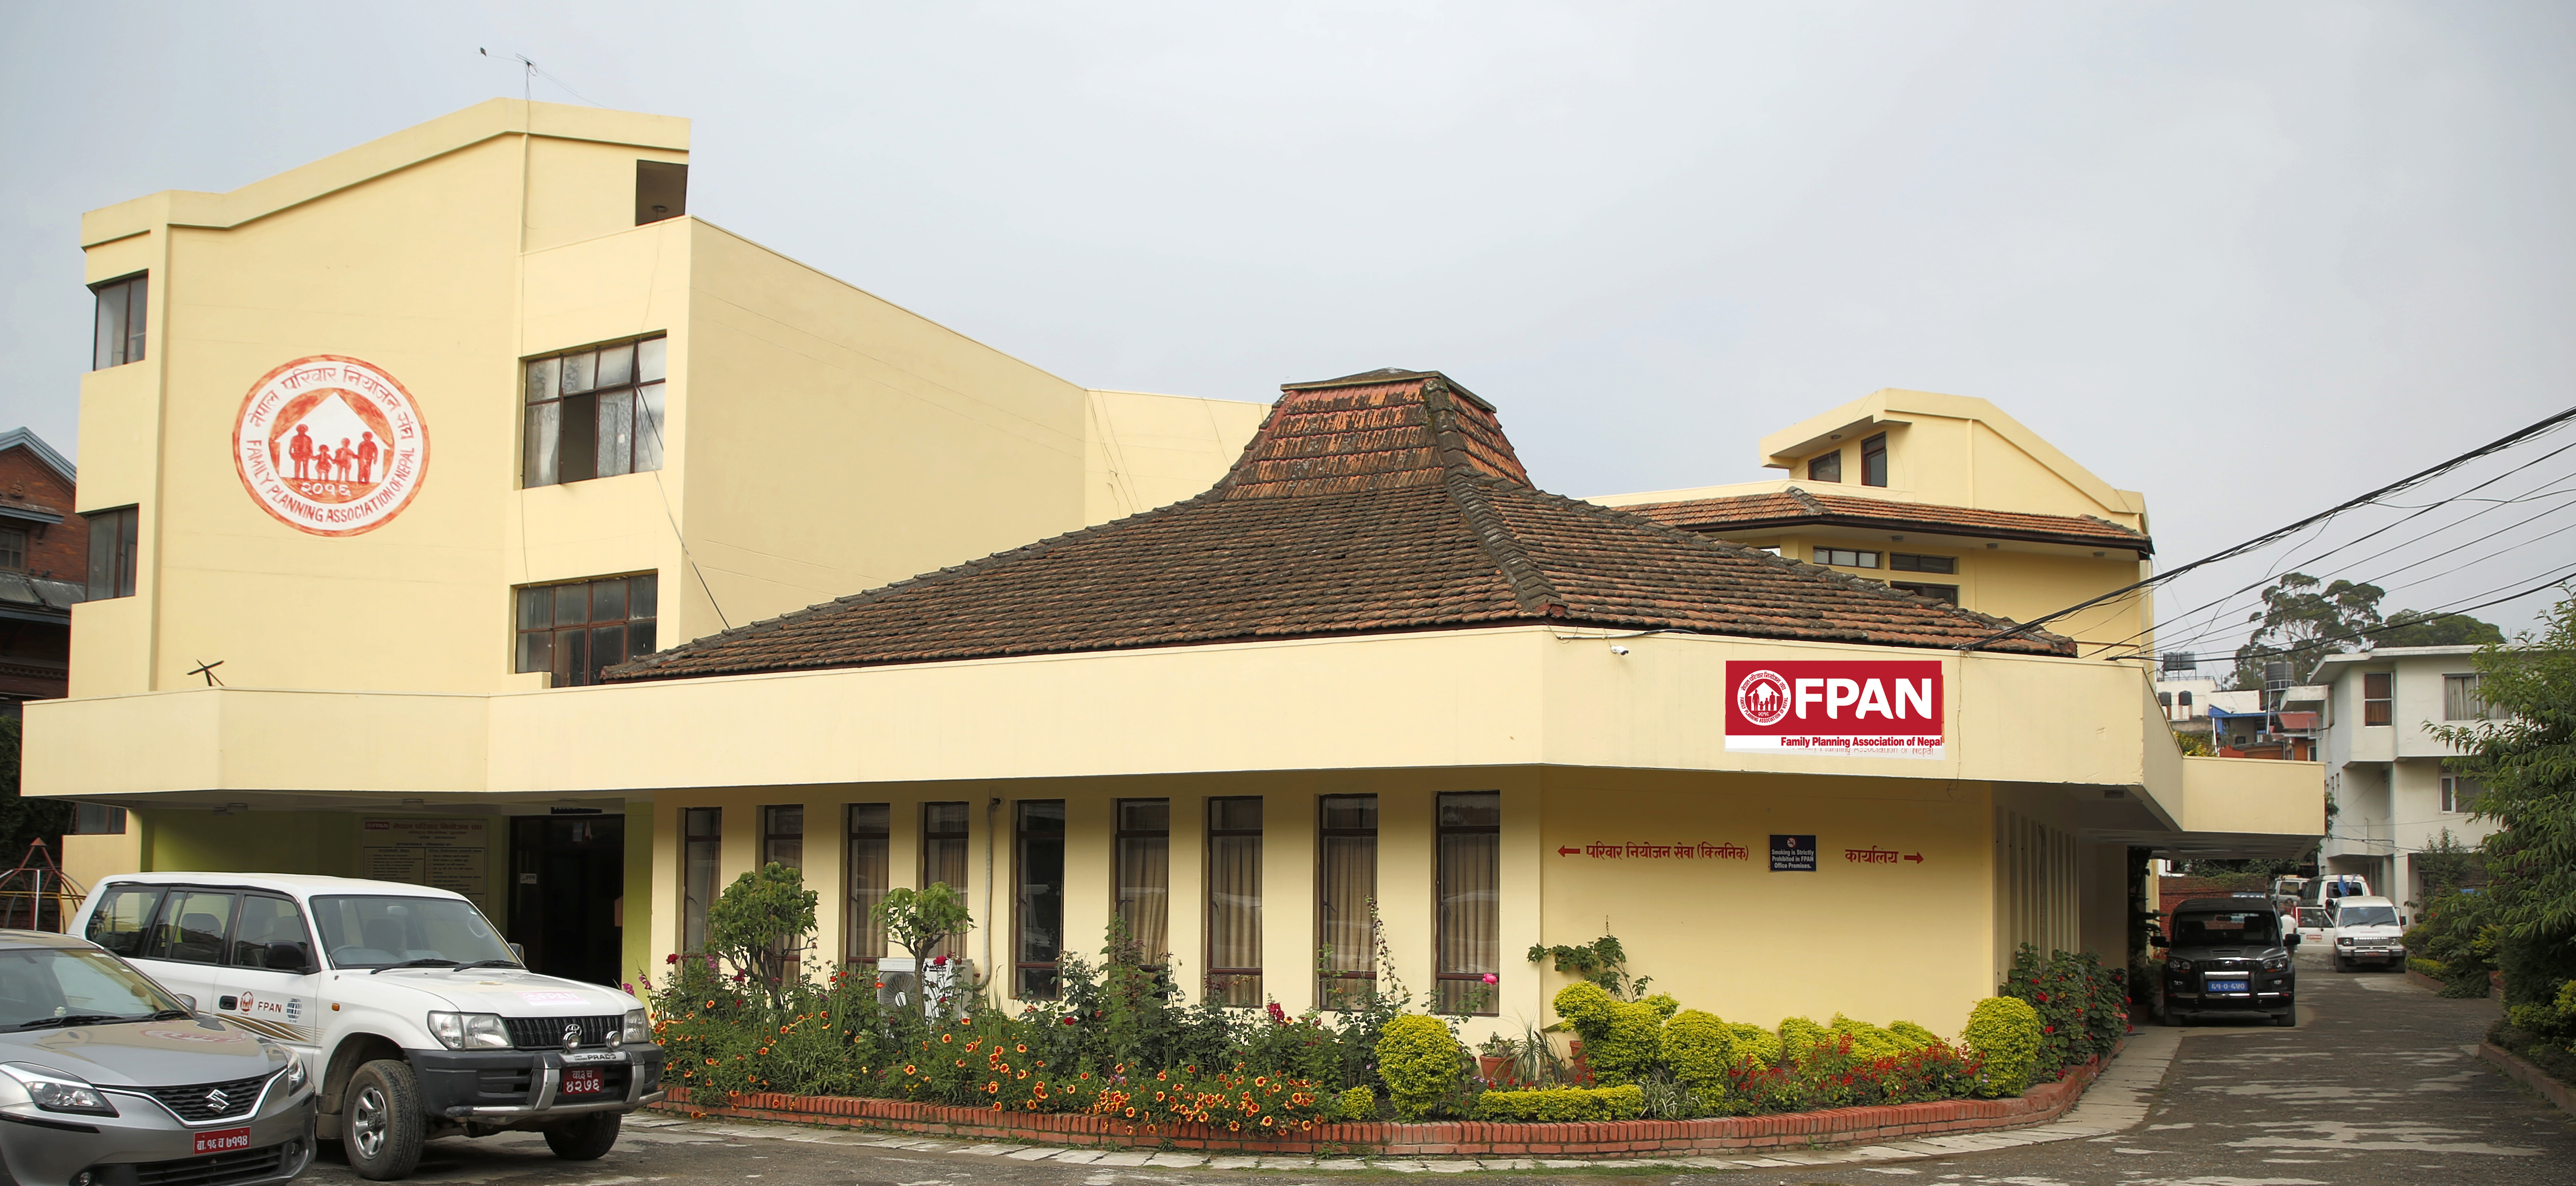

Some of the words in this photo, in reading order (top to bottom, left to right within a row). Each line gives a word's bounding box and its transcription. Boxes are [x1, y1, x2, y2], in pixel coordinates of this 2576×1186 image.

[247, 389, 280, 427] नेपाल
[280, 368, 339, 390] परिवार
[343, 365, 401, 413] नियोजन
[246, 440, 274, 486] FAMILY
[266, 484, 323, 523] PLANNING
[325, 488, 396, 523] ASSOCIATION
[389, 478, 403, 492] OF
[396, 447, 415, 483] NEPAL
[300, 482, 351, 496] २०१६
[1795, 678, 1932, 719] FPAN
[1744, 709, 1759, 722] PLANNING
[1759, 713, 1781, 723] ASSOCIATION
[1781, 737, 1810, 748] Family
[1812, 737, 1850, 748] Planning
[1852, 737, 1904, 746] Association
[1907, 737, 1915, 746] of
[1917, 737, 1942, 748] Nepal
[1586, 840, 1623, 860] परिवार
[1626, 841, 1671, 859] नियोजन
[1673, 841, 1694, 860] सेवा
[1697, 841, 1749, 861] (क्लिनिक)
[1845, 845, 1899, 864] कार्यालय
[258, 1001, 282, 1013] FPAN
[566, 1079, 600, 1092] ४२७६
